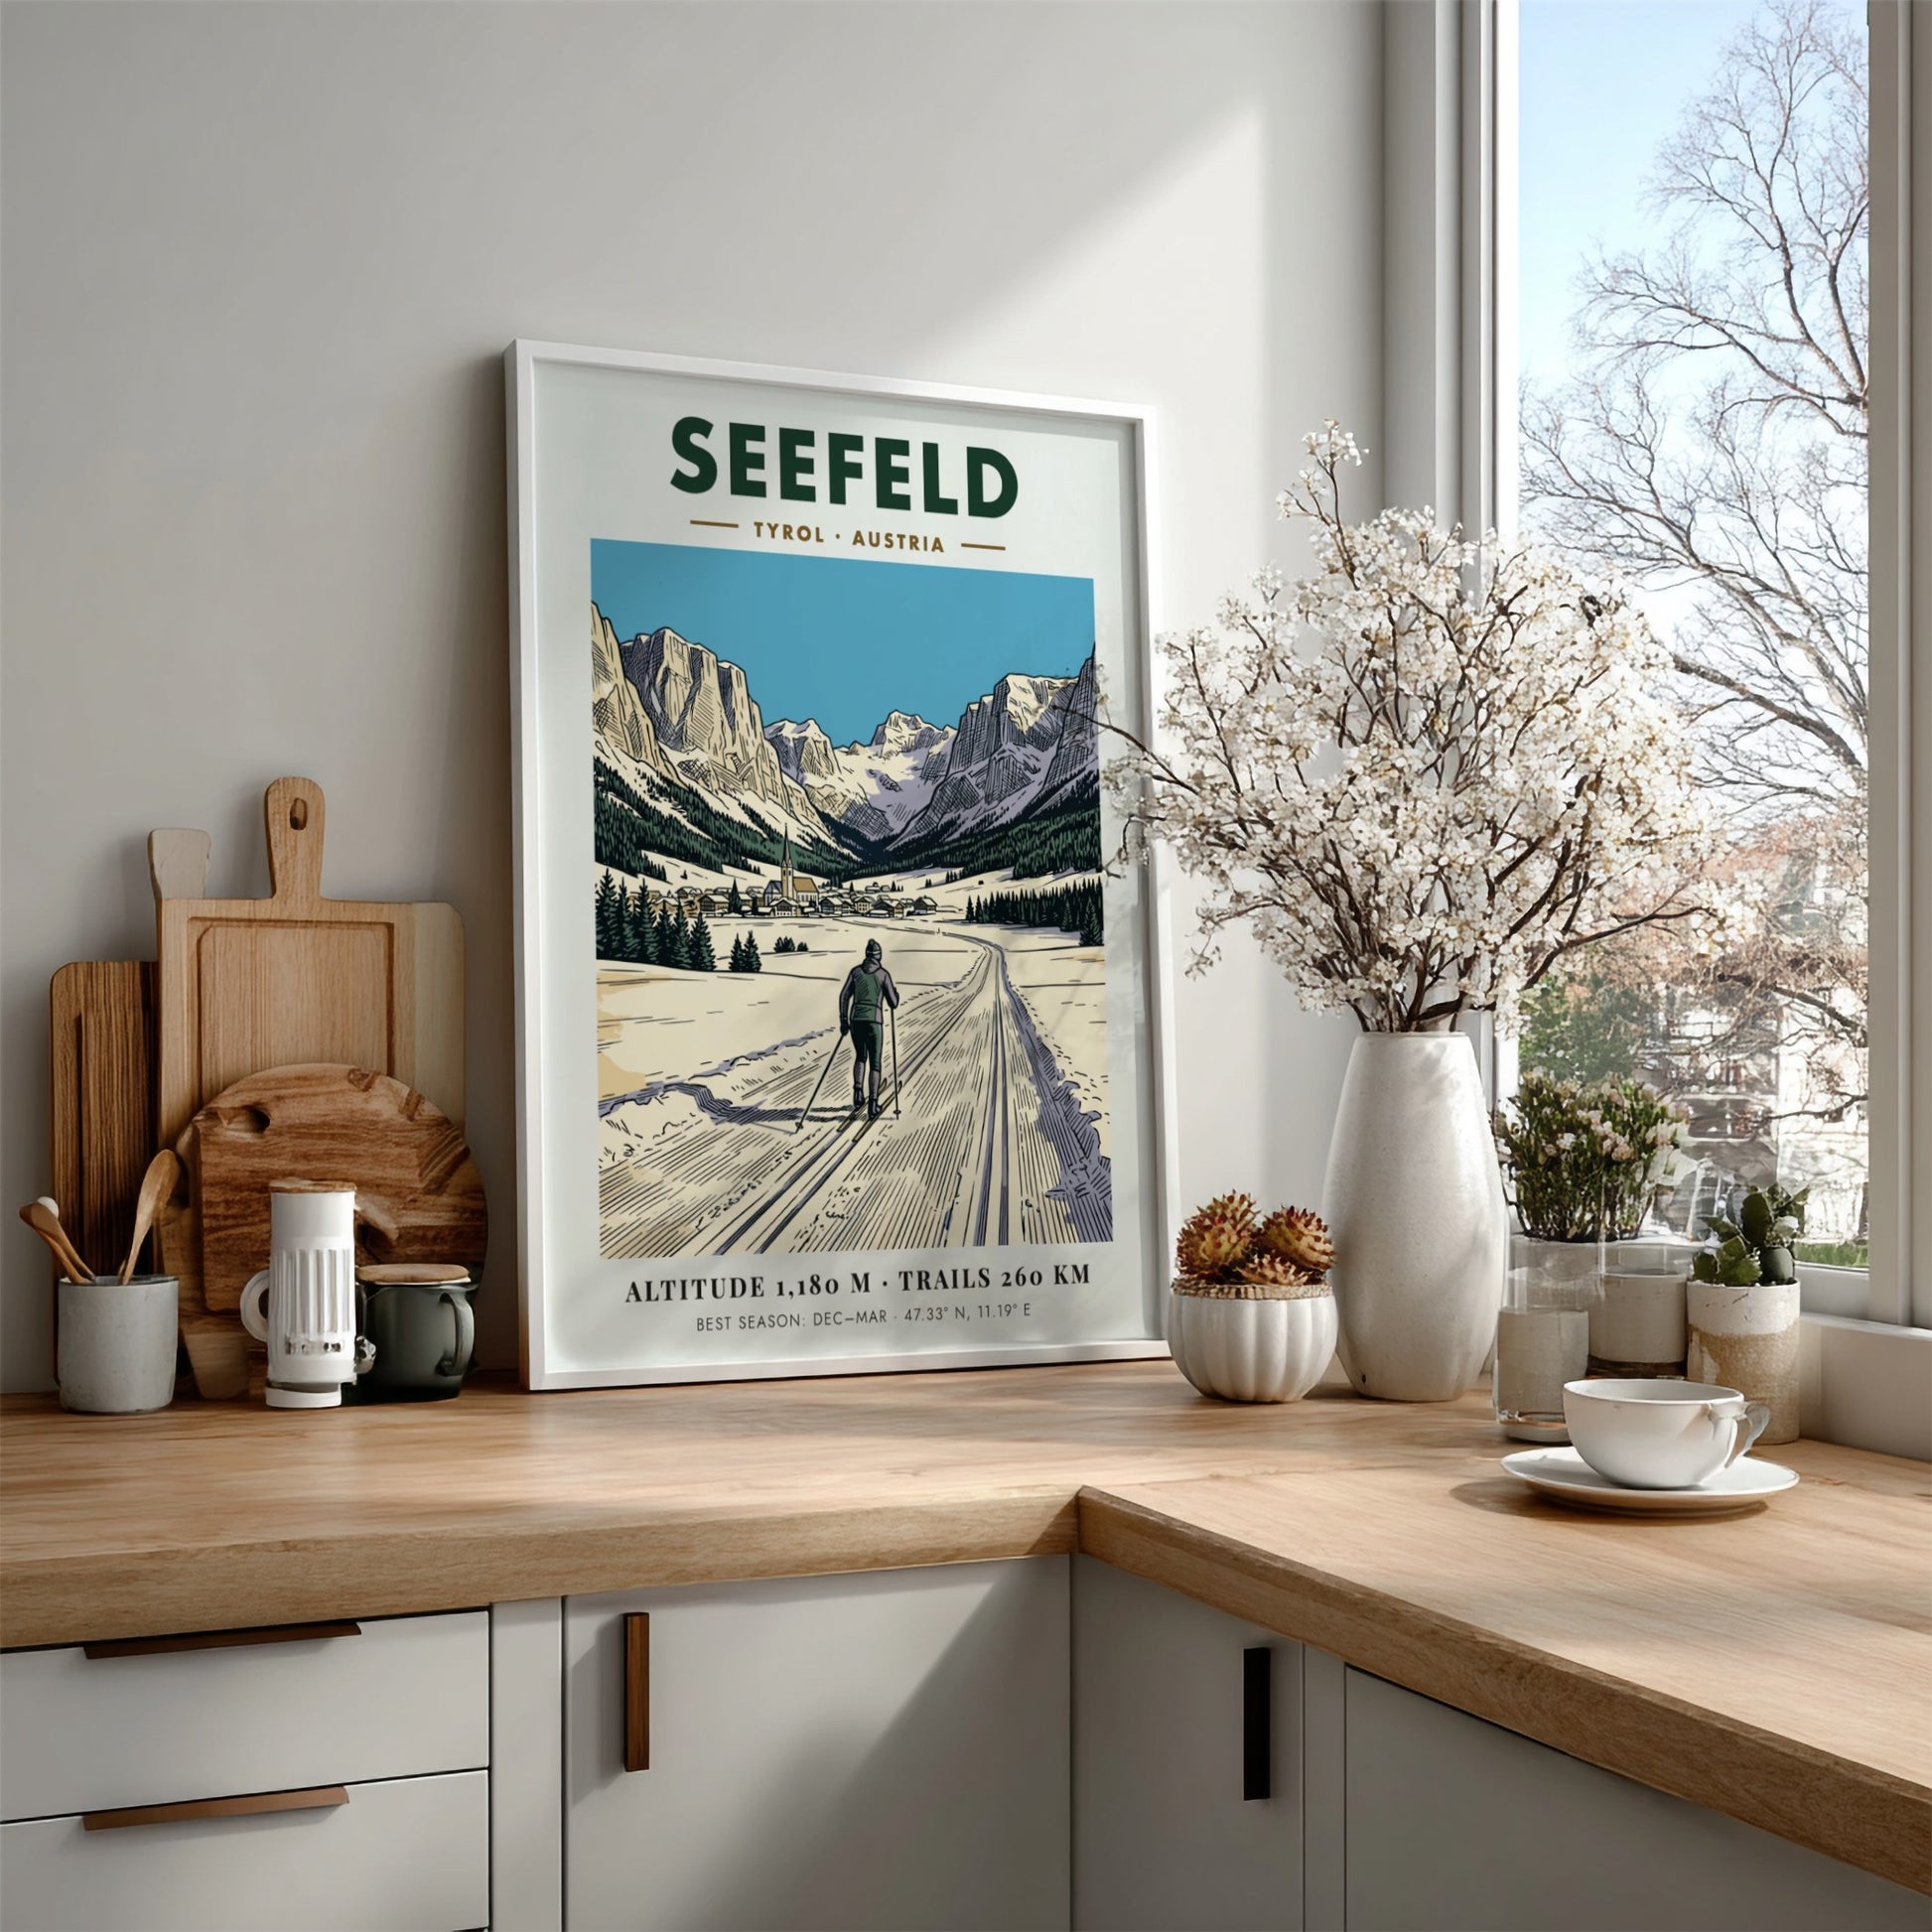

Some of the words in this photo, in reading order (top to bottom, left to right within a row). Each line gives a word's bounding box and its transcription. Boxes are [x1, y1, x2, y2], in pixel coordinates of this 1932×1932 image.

[670, 415, 1019, 519] SEEFELD
[753, 521, 825, 544] TYROL
[851, 529, 945, 553] AUSTRIA
[624, 1277, 765, 1304] ALTITUDE
[776, 1273, 840, 1300] 1,180
[850, 1272, 872, 1294] M
[897, 1267, 991, 1292] TRAILS
[1001, 1266, 1043, 1288] 260
[1053, 1263, 1091, 1286] KM
[696, 1315, 733, 1332] BEST
[738, 1312, 806, 1330] SEASON:
[903, 1306, 949, 1322] 47.33°
[954, 1306, 971, 1322] N,
[977, 1303, 1019, 1319] 11.19°
[1023, 1303, 1032, 1316] E
